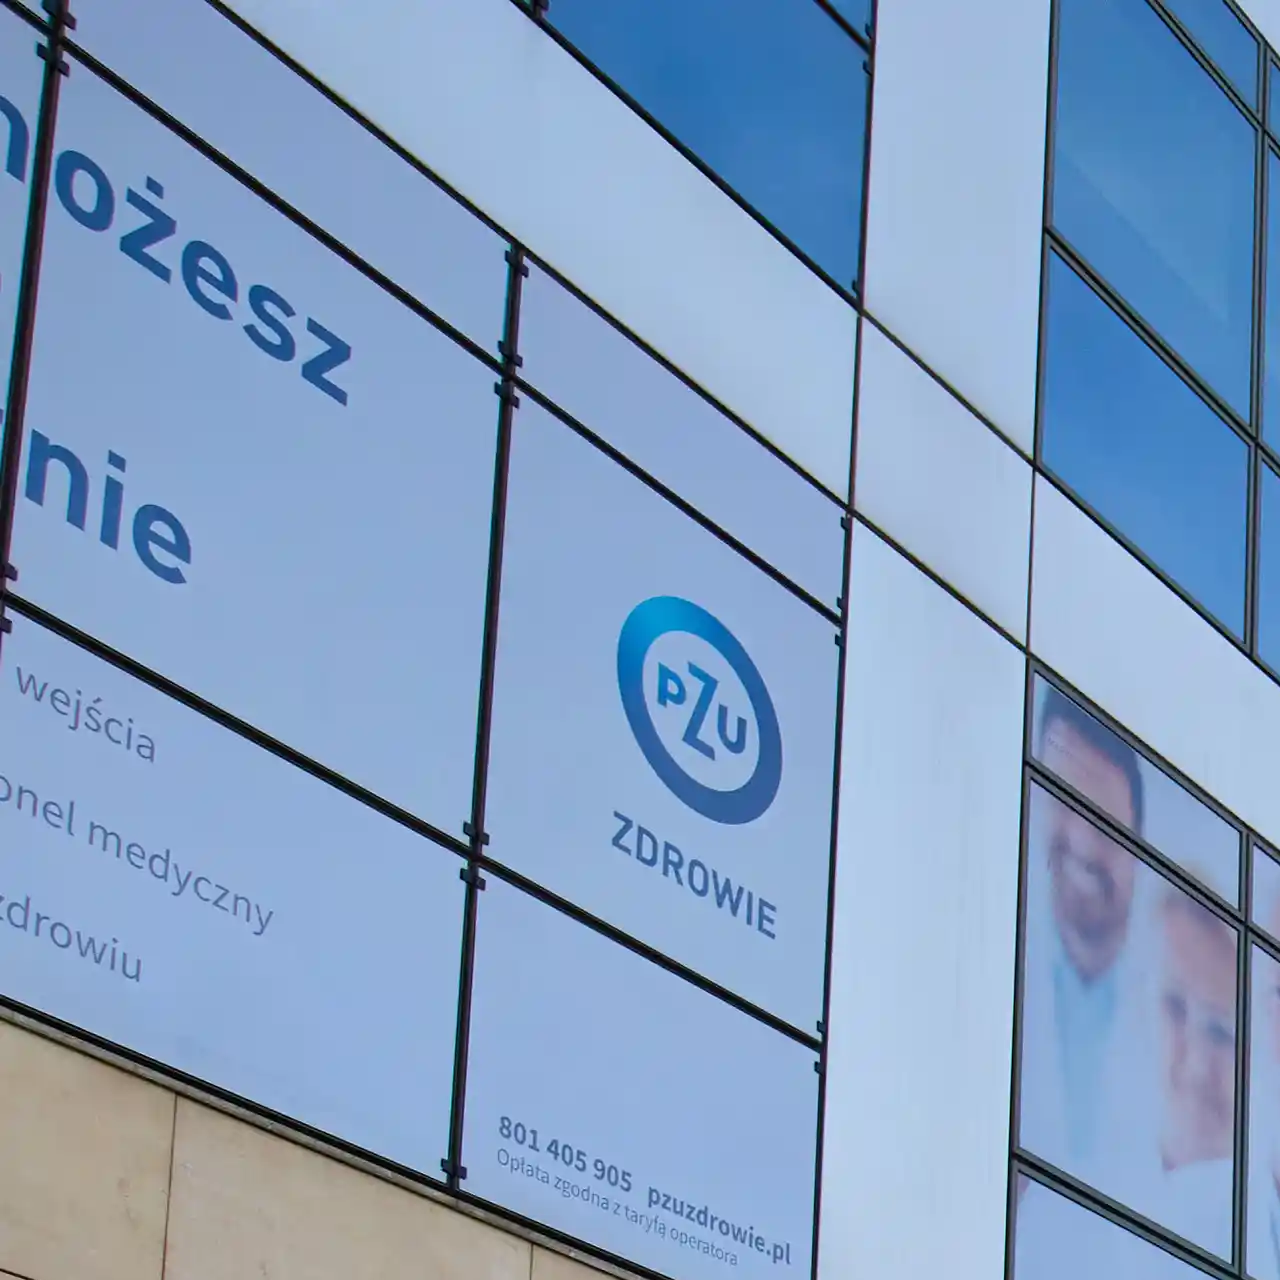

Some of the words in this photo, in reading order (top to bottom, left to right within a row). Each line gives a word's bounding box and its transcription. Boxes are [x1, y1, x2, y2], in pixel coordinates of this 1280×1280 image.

[24, 428, 193, 586] nie
[16, 666, 156, 763] wejścia
[656, 660, 748, 762] PZU
[88, 820, 274, 936] medyczny
[611, 810, 778, 940] ZDROWIE
[496, 1148, 551, 1185] Opłata
[553, 1174, 610, 1211] zgodna
[612, 1200, 621, 1216] z
[623, 1206, 666, 1240] taryfą
[670, 1226, 739, 1267] operatora
[498, 1116, 540, 1153] 801
[546, 1138, 588, 1173] 405
[593, 1158, 633, 1193] 905
[647, 1185, 792, 1266] pzuzdrowie.pl
